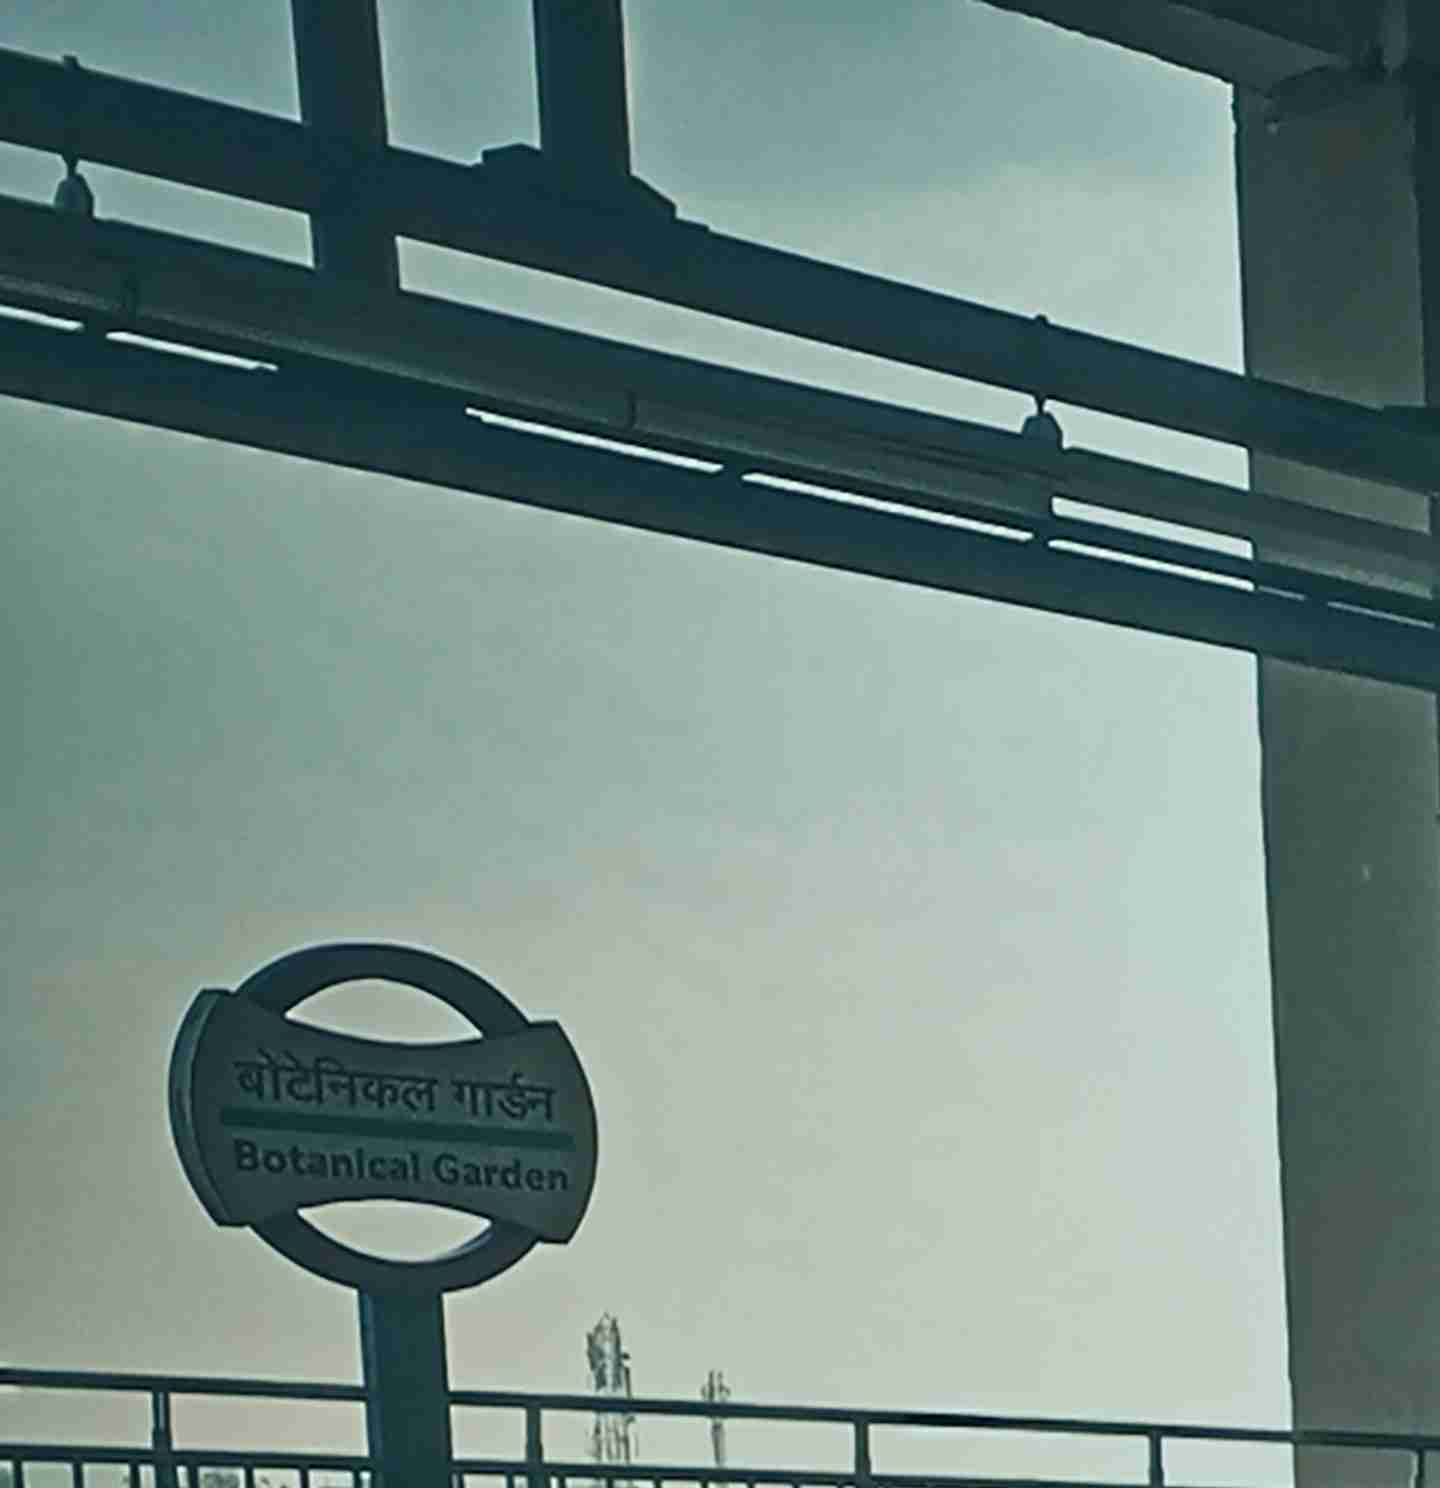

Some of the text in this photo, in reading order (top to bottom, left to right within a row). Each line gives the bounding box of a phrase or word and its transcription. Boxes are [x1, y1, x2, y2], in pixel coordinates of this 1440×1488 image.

[450, 1071, 558, 1122] गार्डन
[233, 1138, 570, 1193] Botanical Garden
